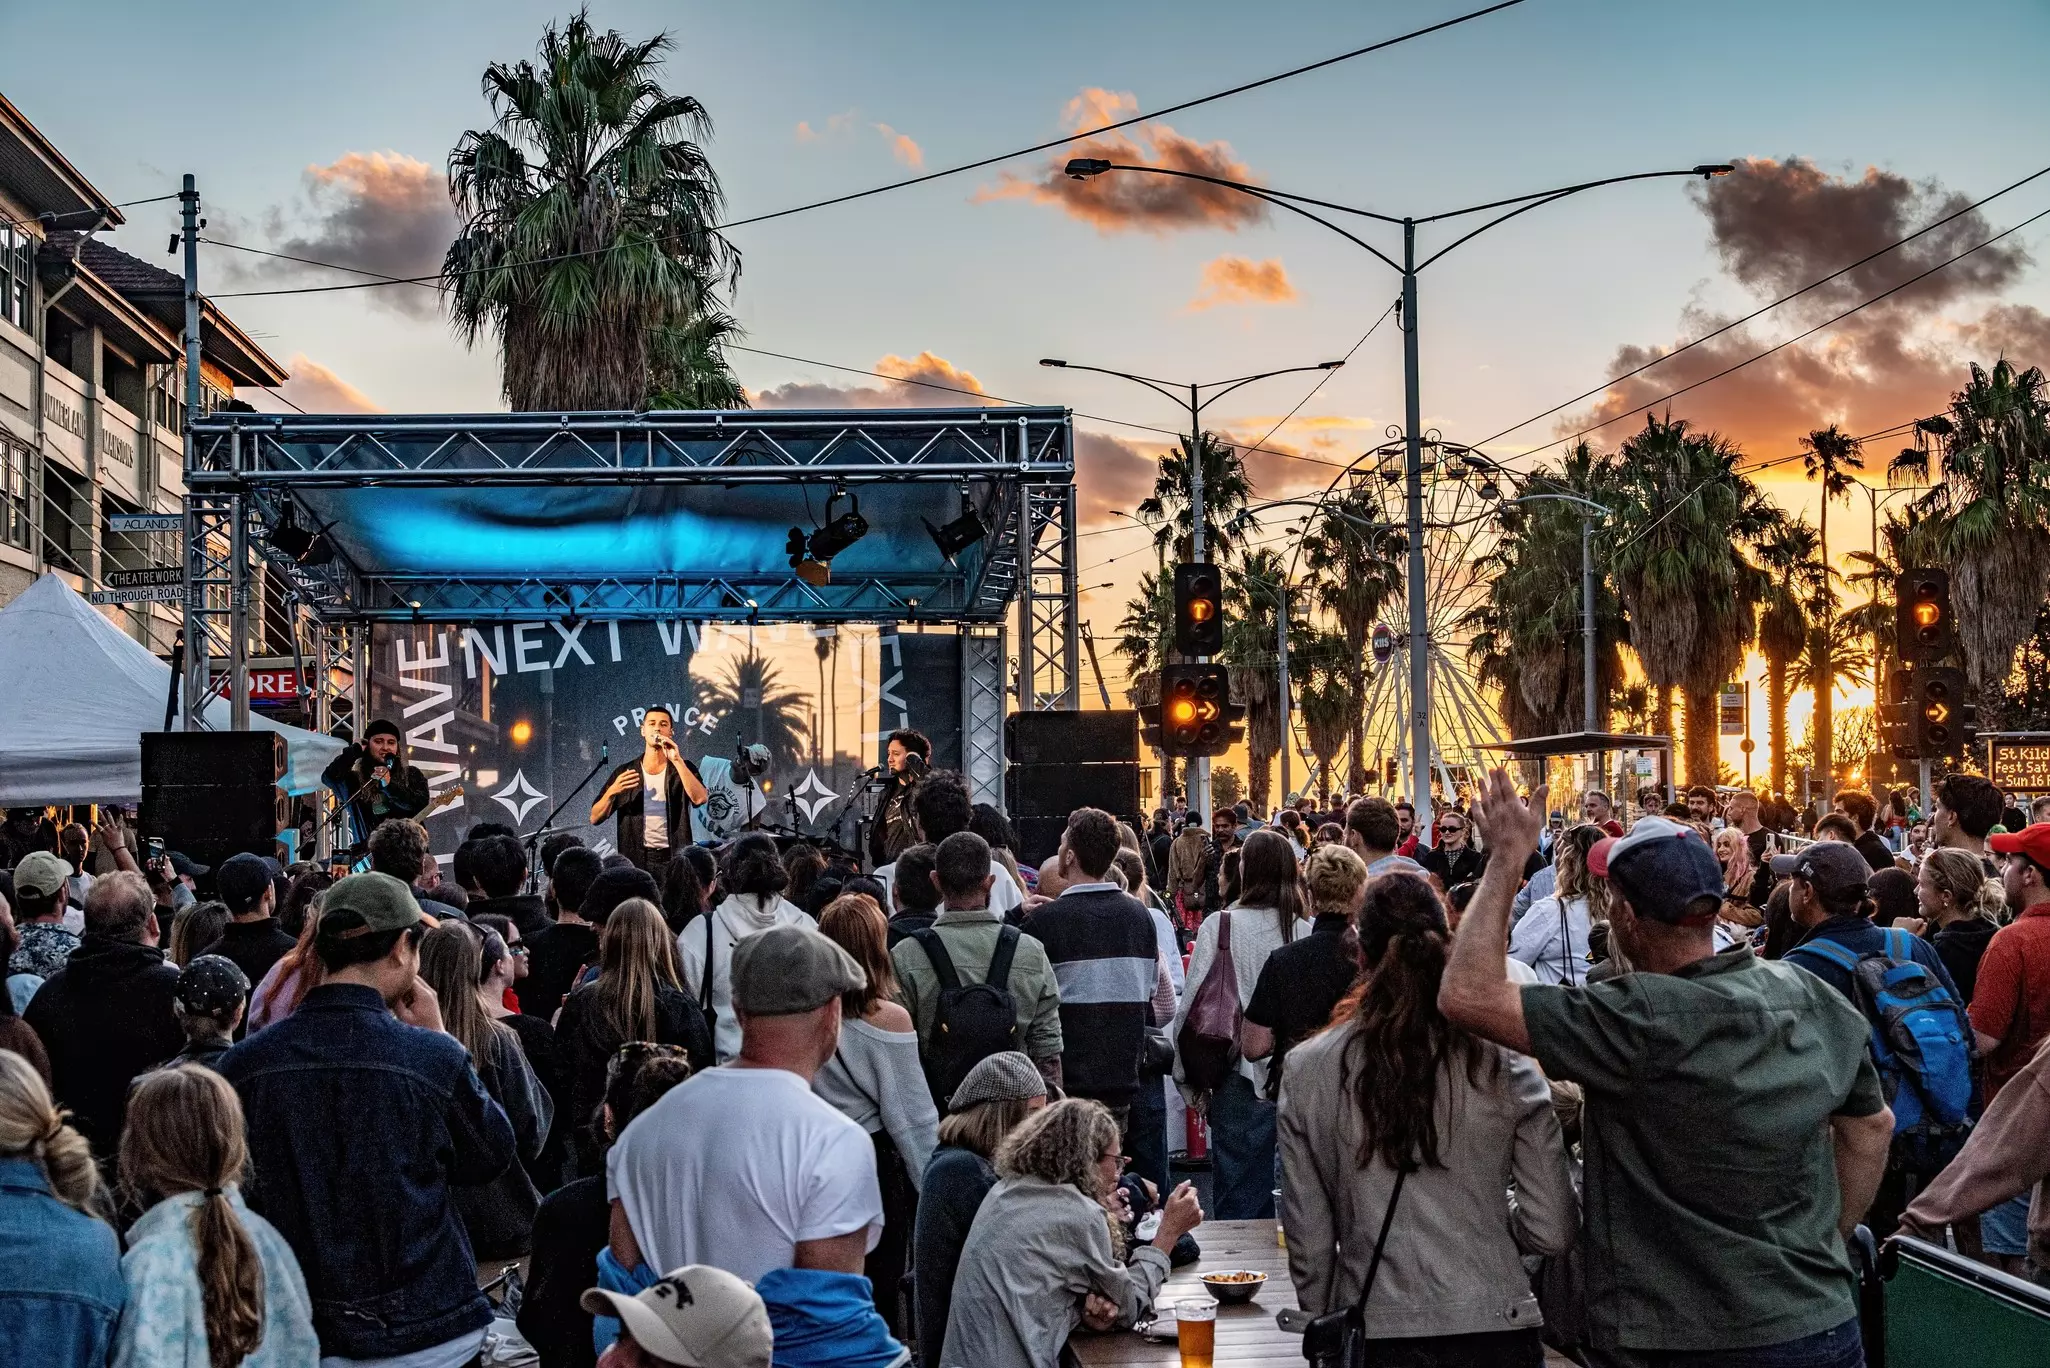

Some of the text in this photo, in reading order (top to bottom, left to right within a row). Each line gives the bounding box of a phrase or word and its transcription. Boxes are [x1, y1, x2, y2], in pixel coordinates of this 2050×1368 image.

[44, 392, 134, 469] UMMERLAND MANSIONS
[124, 519, 183, 530] ACLAND ST
[113, 570, 182, 585] THEATREWORK
[91, 587, 183, 604] NO THROUGH ROAD
[1374, 637, 1390, 649] KIIS
[461, 621, 622, 680] NEXT
[209, 674, 293, 693] TORE
[612, 703, 720, 737] PRNCE
[1416, 711, 1427, 720] 32
[1419, 719, 1425, 728] A
[1999, 747, 2050, 760] St Kild
[1995, 761, 2049, 774] Fest Sat
[2006, 774, 2028, 787] Sun
[2030, 774, 2045, 787] 16
